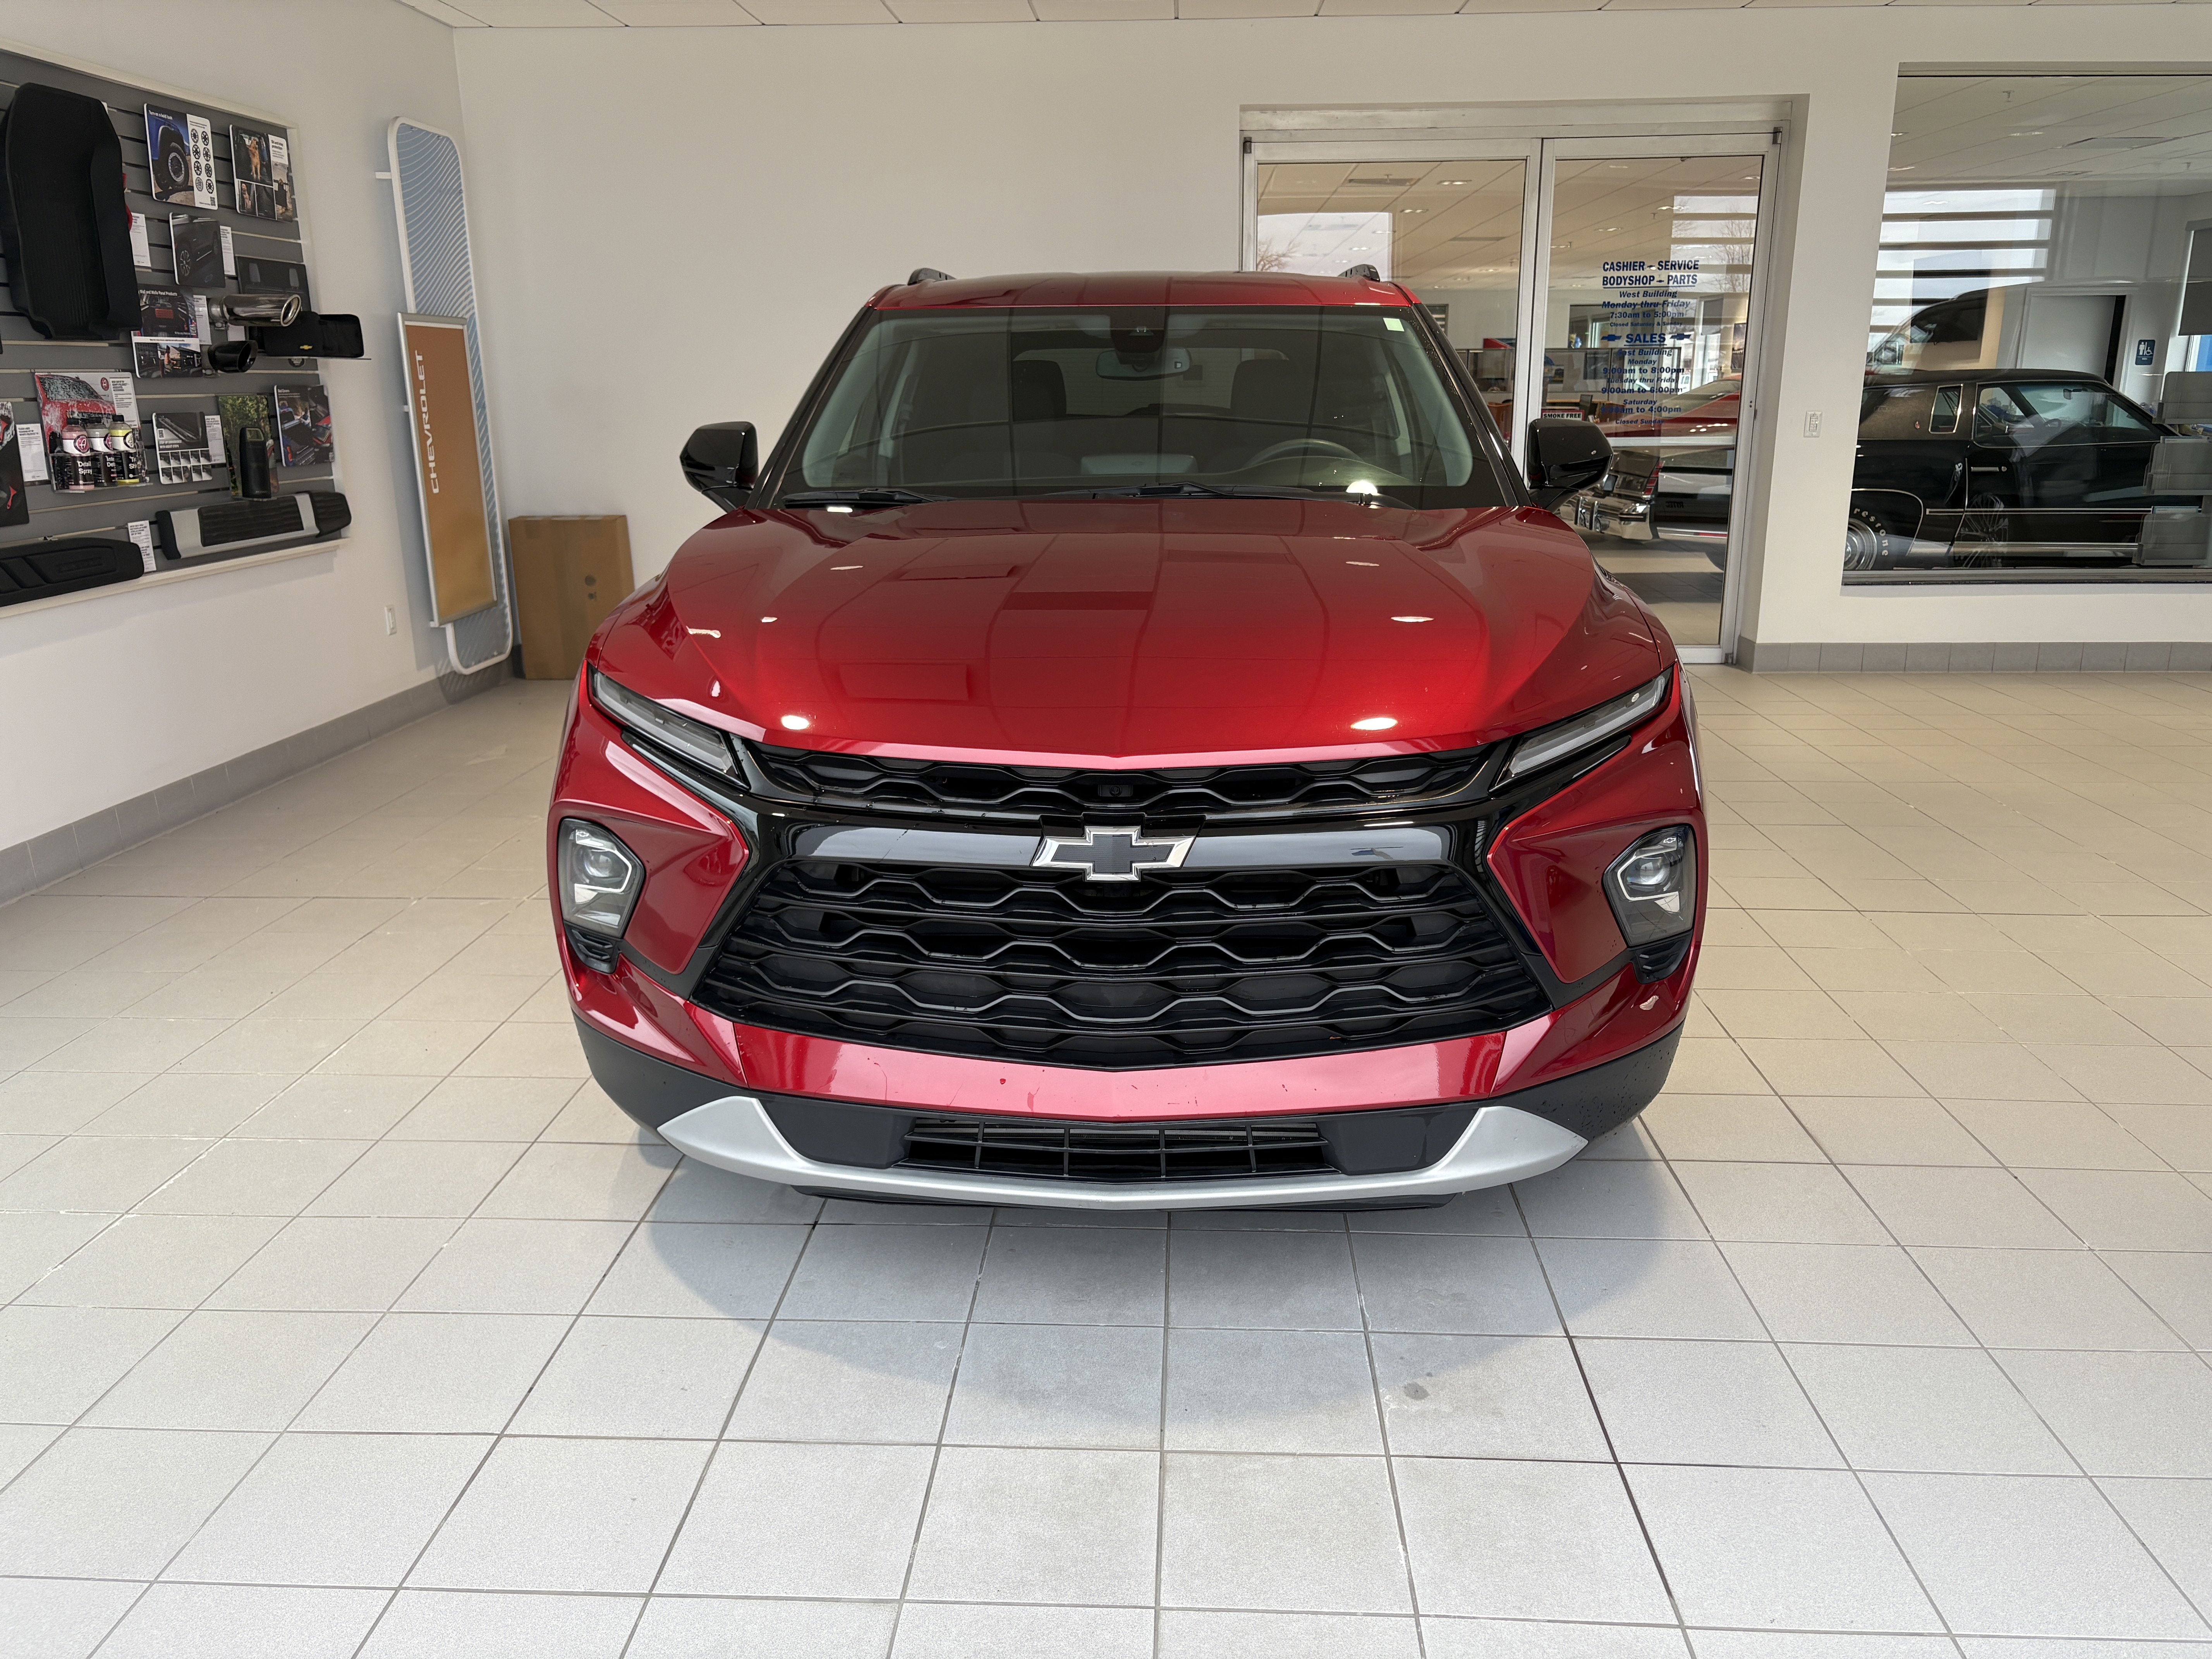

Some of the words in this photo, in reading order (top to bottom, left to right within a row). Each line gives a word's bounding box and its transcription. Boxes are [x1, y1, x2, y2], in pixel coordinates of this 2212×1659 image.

[1603, 261, 1645, 271] CASHIER
[1657, 260, 1699, 270] SERVICE
[1602, 275, 1655, 285] BODYSHOP
[1667, 275, 1697, 285] PARTS
[1602, 301, 1638, 309] Monday
[1625, 333, 1666, 343] SALES
[1638, 349, 1673, 357] Building
[1651, 367, 1684, 375] 8:00pm
[415, 350, 439, 494] CHEVROLET
[1853, 508, 1888, 556] restone
